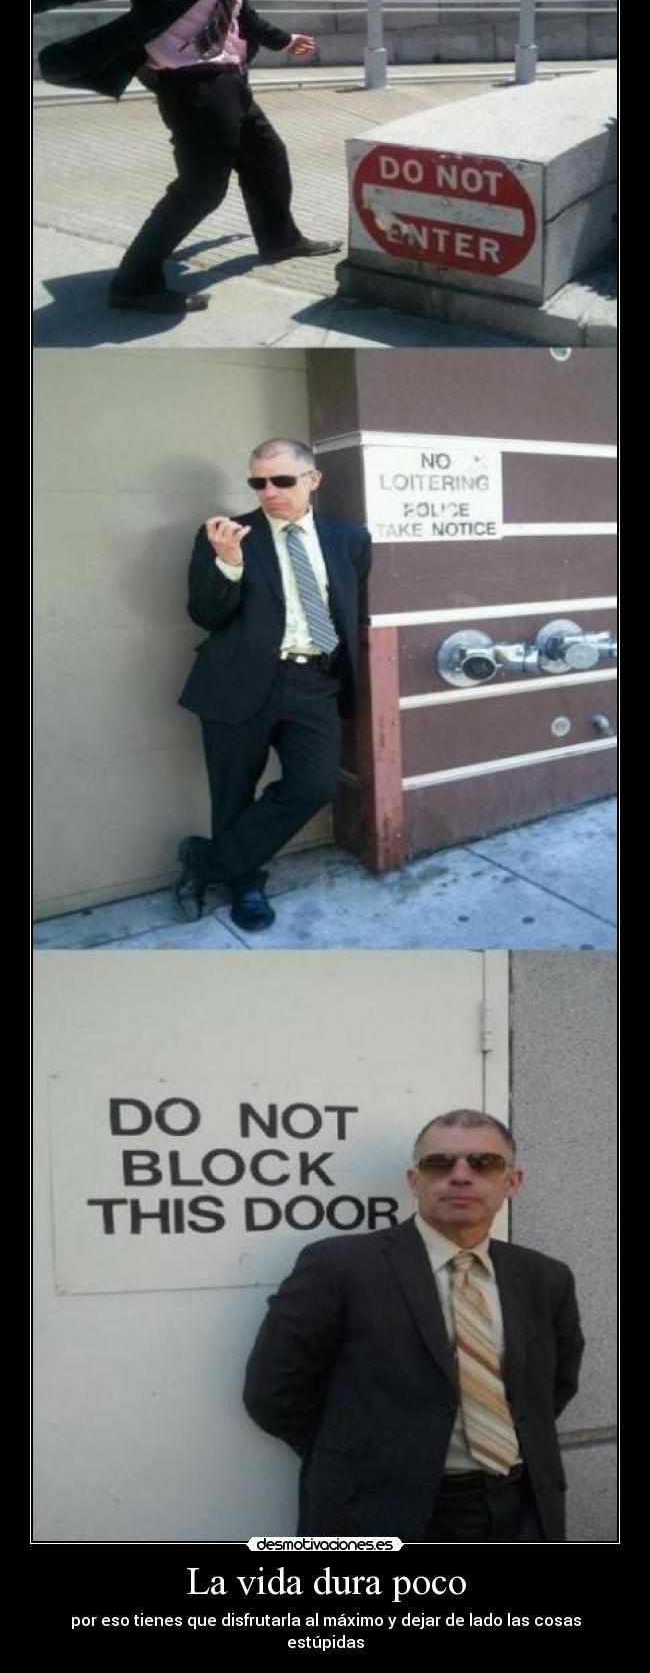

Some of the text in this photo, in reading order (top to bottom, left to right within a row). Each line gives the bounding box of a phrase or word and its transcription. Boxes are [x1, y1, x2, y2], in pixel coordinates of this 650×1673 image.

[379, 155, 503, 197] DO NOT
[385, 219, 500, 264] ENTER
[421, 453, 451, 469] NO
[379, 474, 489, 491] LOITERING
[376, 521, 496, 538] TAKE NOTICE
[109, 1097, 359, 1140] DO NOT
[122, 1148, 335, 1186] BLOCK
[87, 1195, 399, 1234] THIS DOOR
